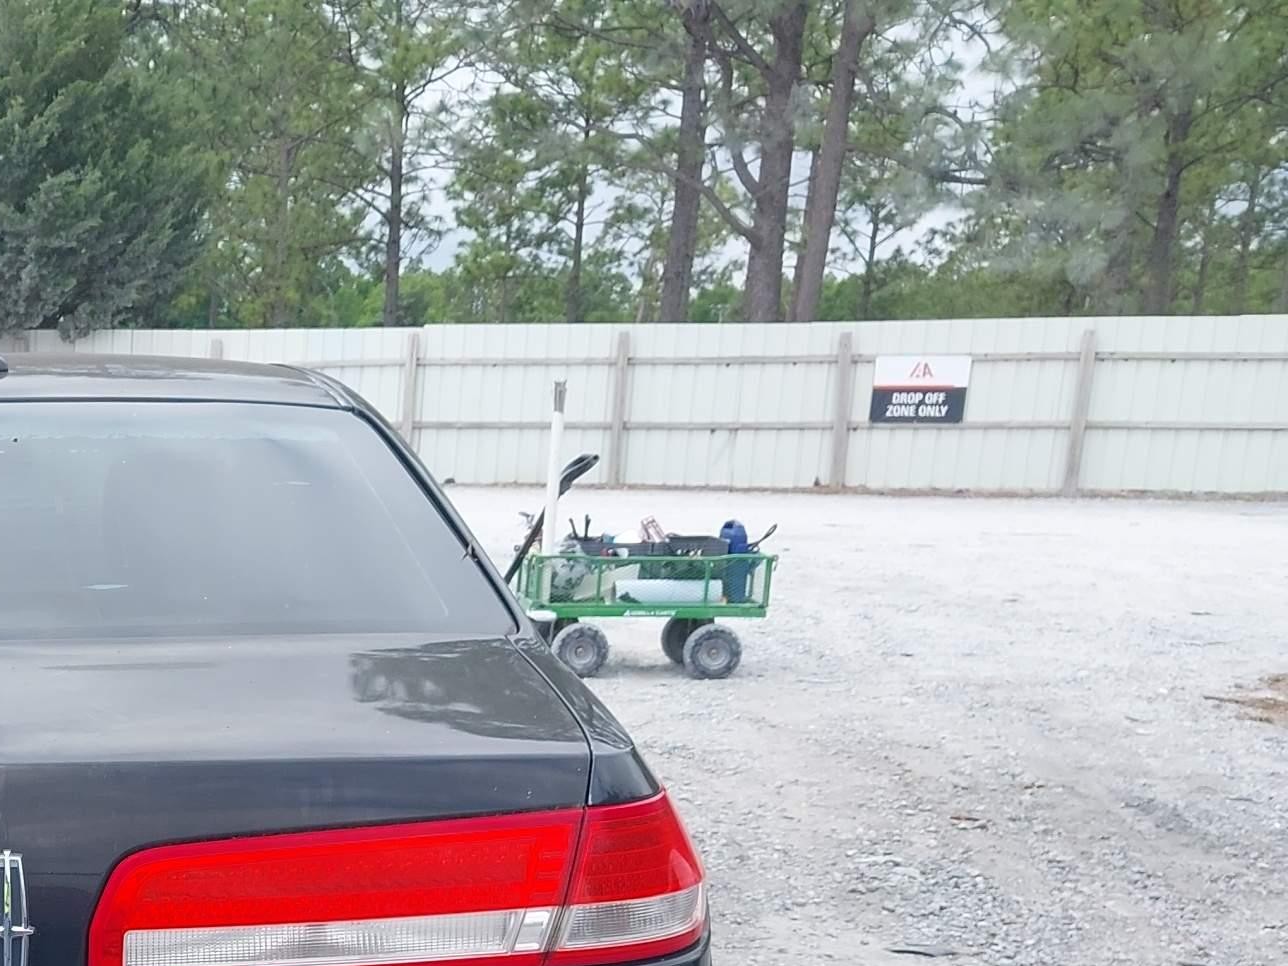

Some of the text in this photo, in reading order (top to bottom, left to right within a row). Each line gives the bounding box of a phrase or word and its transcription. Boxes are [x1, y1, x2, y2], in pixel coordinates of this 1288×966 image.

[892, 391, 946, 405] DROP OFF
[885, 404, 949, 417] ZONE ONLY
